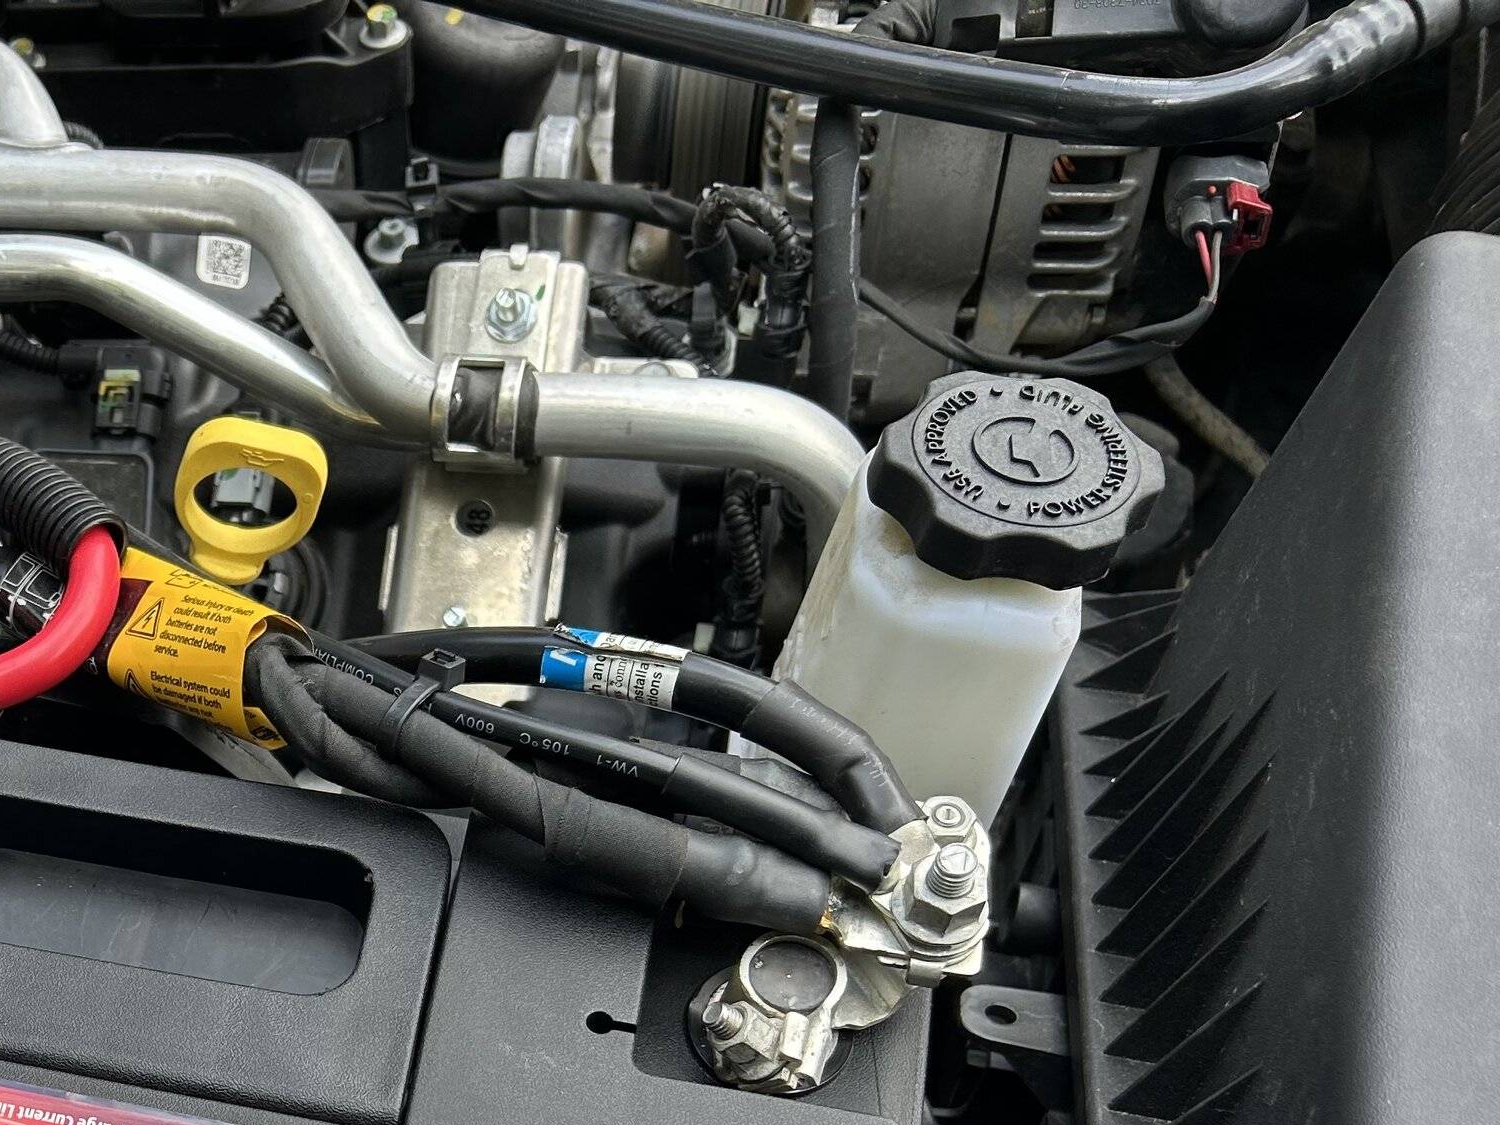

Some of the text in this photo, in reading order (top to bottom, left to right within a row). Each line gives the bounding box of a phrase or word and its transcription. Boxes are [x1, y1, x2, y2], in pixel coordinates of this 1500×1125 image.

[925, 389, 984, 501] USE APPROVED
[1019, 385, 1129, 518] POWER STEERING FLUID
[165, 615, 217, 635] batteries are not
[154, 642, 179, 657] service.
[159, 629, 227, 653] disconnected before
[148, 670, 231, 698] Electrical system could
[454, 711, 495, 733] 600V
[517, 729, 571, 756] 105°C
[594, 753, 640, 777] VW-1
